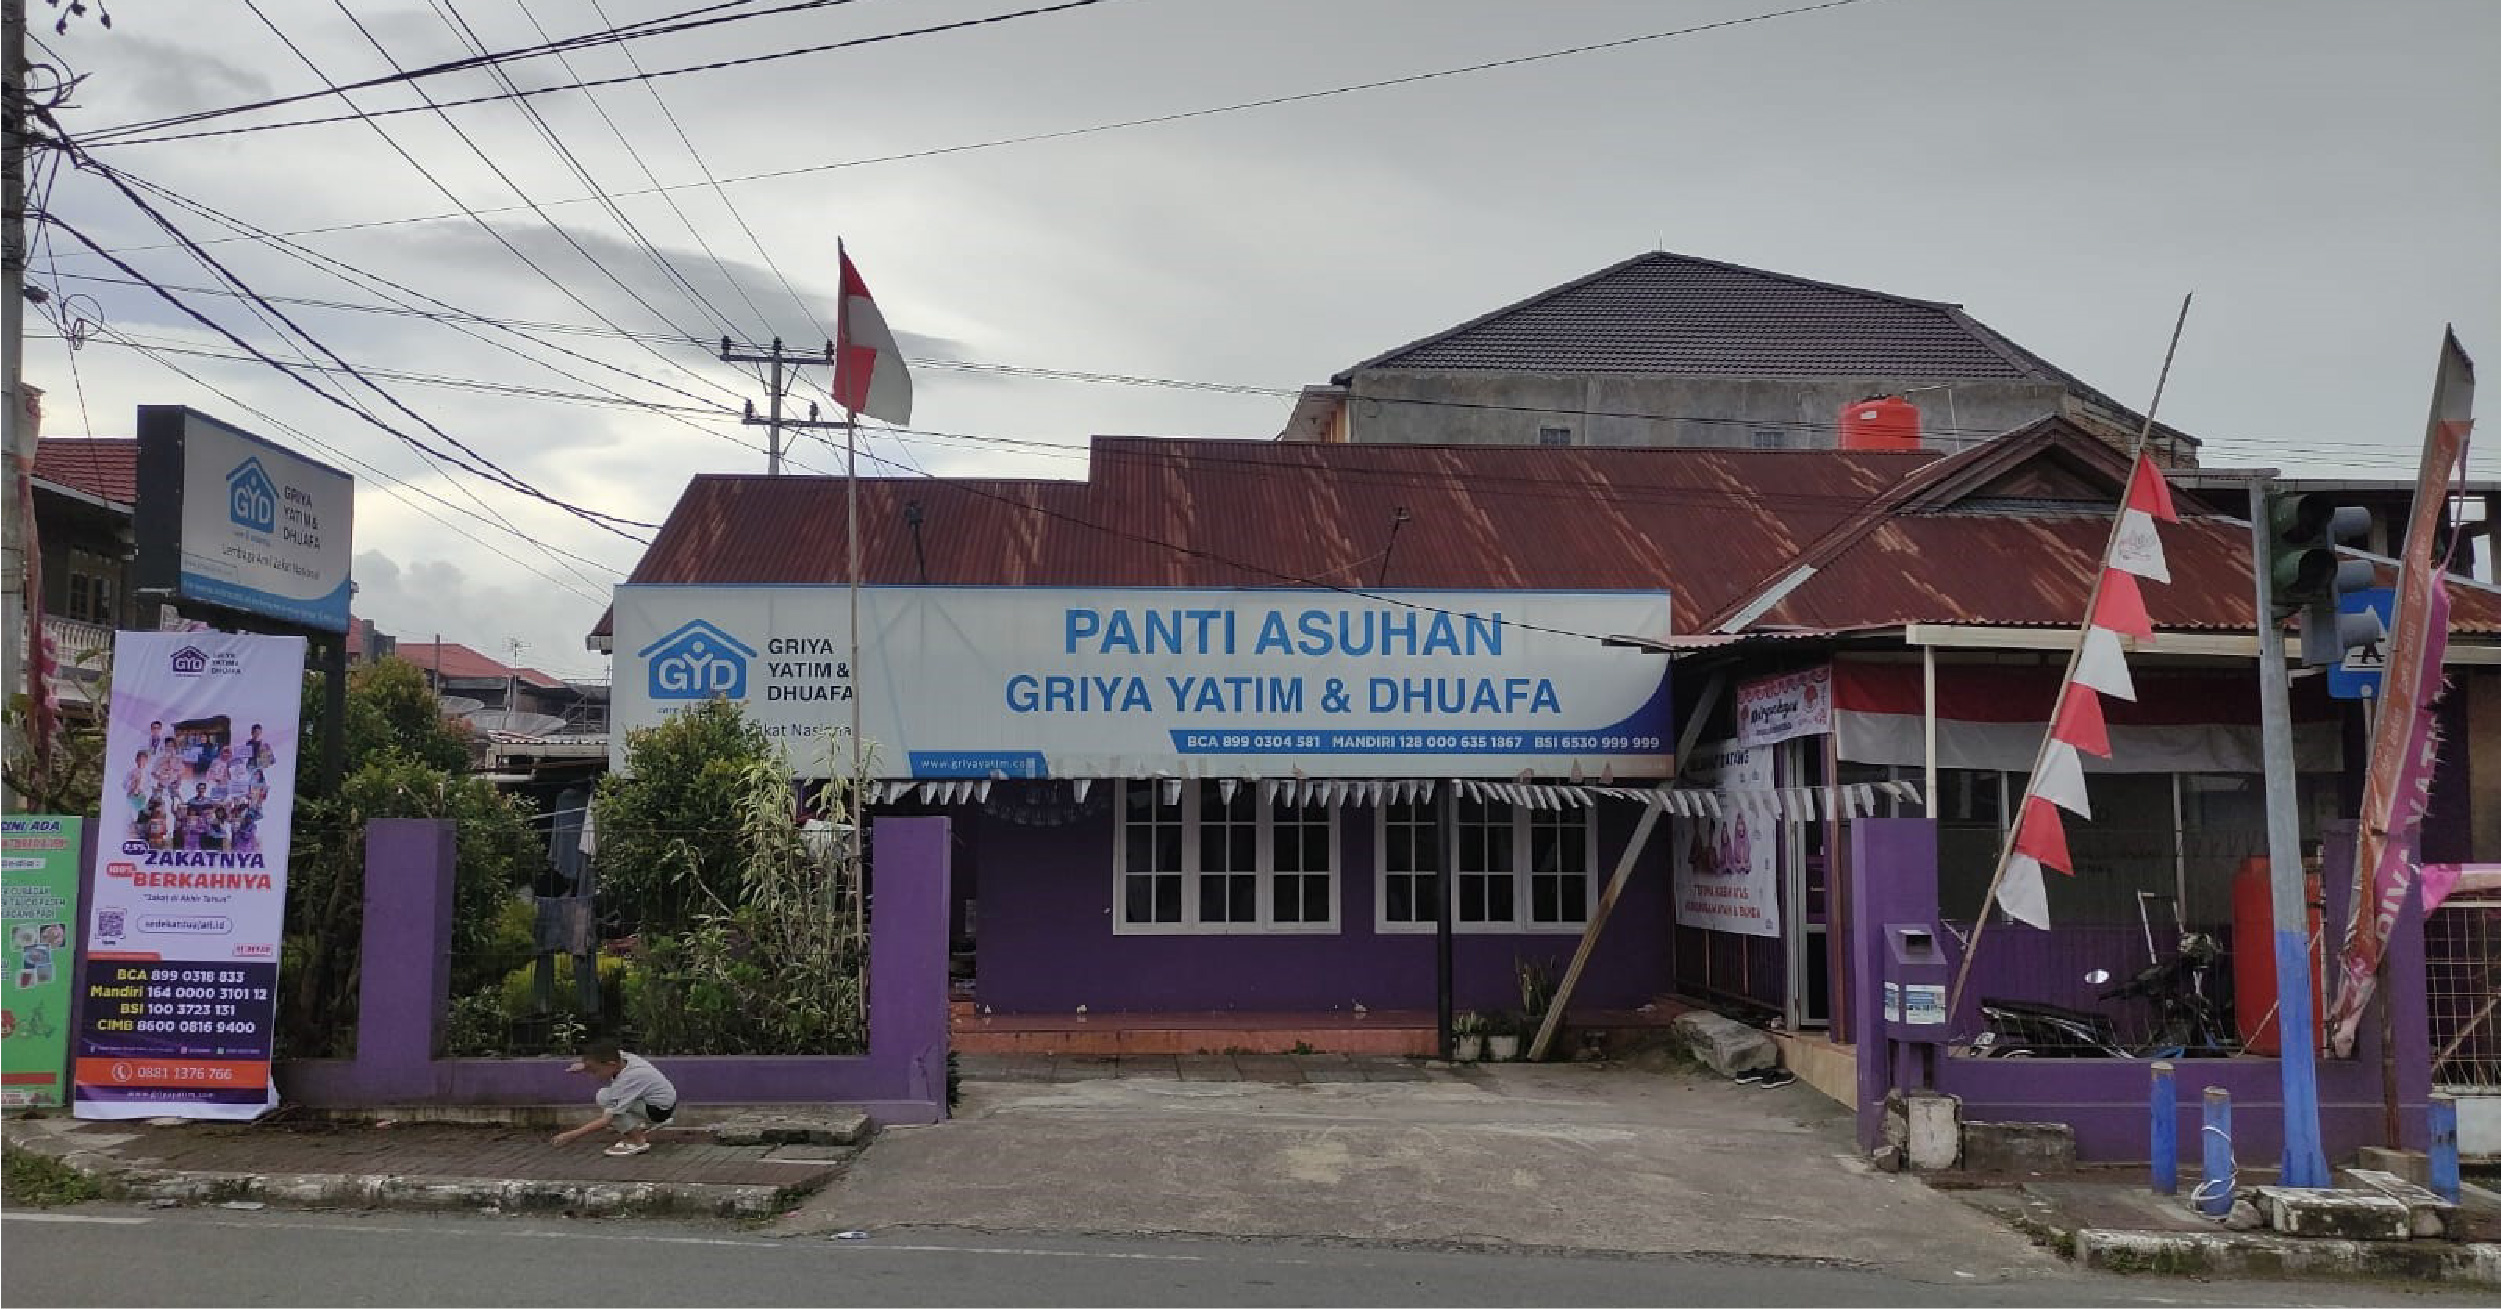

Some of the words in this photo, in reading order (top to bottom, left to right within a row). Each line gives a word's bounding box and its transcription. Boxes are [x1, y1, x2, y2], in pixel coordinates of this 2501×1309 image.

[233, 485, 270, 523] GYD
[1065, 609, 1235, 655] PANTI
[1255, 609, 1502, 656] ASUHAN
[768, 638, 834, 655] GRIYA
[176, 656, 202, 671] GYD
[658, 653, 738, 690] GYD
[768, 662, 832, 678] YATIM
[836, 662, 850, 678] &
[767, 685, 853, 701] DHUAFA
[1005, 674, 1153, 713] GRIYA
[1165, 676, 1303, 713] YATIM
[1320, 677, 1352, 714] &
[1369, 678, 1561, 714] DHUAFA
[791, 723, 852, 737] Nasiona
[1187, 735, 1219, 747] BCA
[1223, 735, 1250, 747] 899
[1254, 736, 1293, 748] 0304
[1297, 736, 1321, 748] 581
[1332, 736, 1396, 748] MANDIRI
[1399, 736, 1423, 748] 128
[1426, 736, 1457, 748] 000
[1461, 736, 1487, 748] 635
[1491, 736, 1523, 748] 1867
[1534, 737, 1558, 748] BSI
[1562, 737, 1597, 748] 6530
[1601, 737, 1628, 748] 999
[1632, 737, 1660, 749] 999
[145, 851, 265, 868] ZAKATNYA
[134, 872, 271, 889] BERKAHNYA
[117, 969, 147, 980] BCA
[151, 971, 177, 981] 899
[219, 972, 245, 983] 833
[91, 985, 144, 997] Mandiri
[148, 986, 171, 997] 164
[175, 988, 215, 998] 0000
[219, 988, 249, 999] 3101
[254, 989, 267, 1000] 12
[120, 1004, 143, 1014] BSI
[148, 1004, 173, 1014] 100
[176, 1005, 210, 1015] 3723
[215, 1005, 235, 1016] 131
[98, 1019, 133, 1031] CIMB
[137, 1021, 174, 1032] 8600
[179, 1022, 213, 1032] 0816
[216, 1022, 255, 1033] 9400
